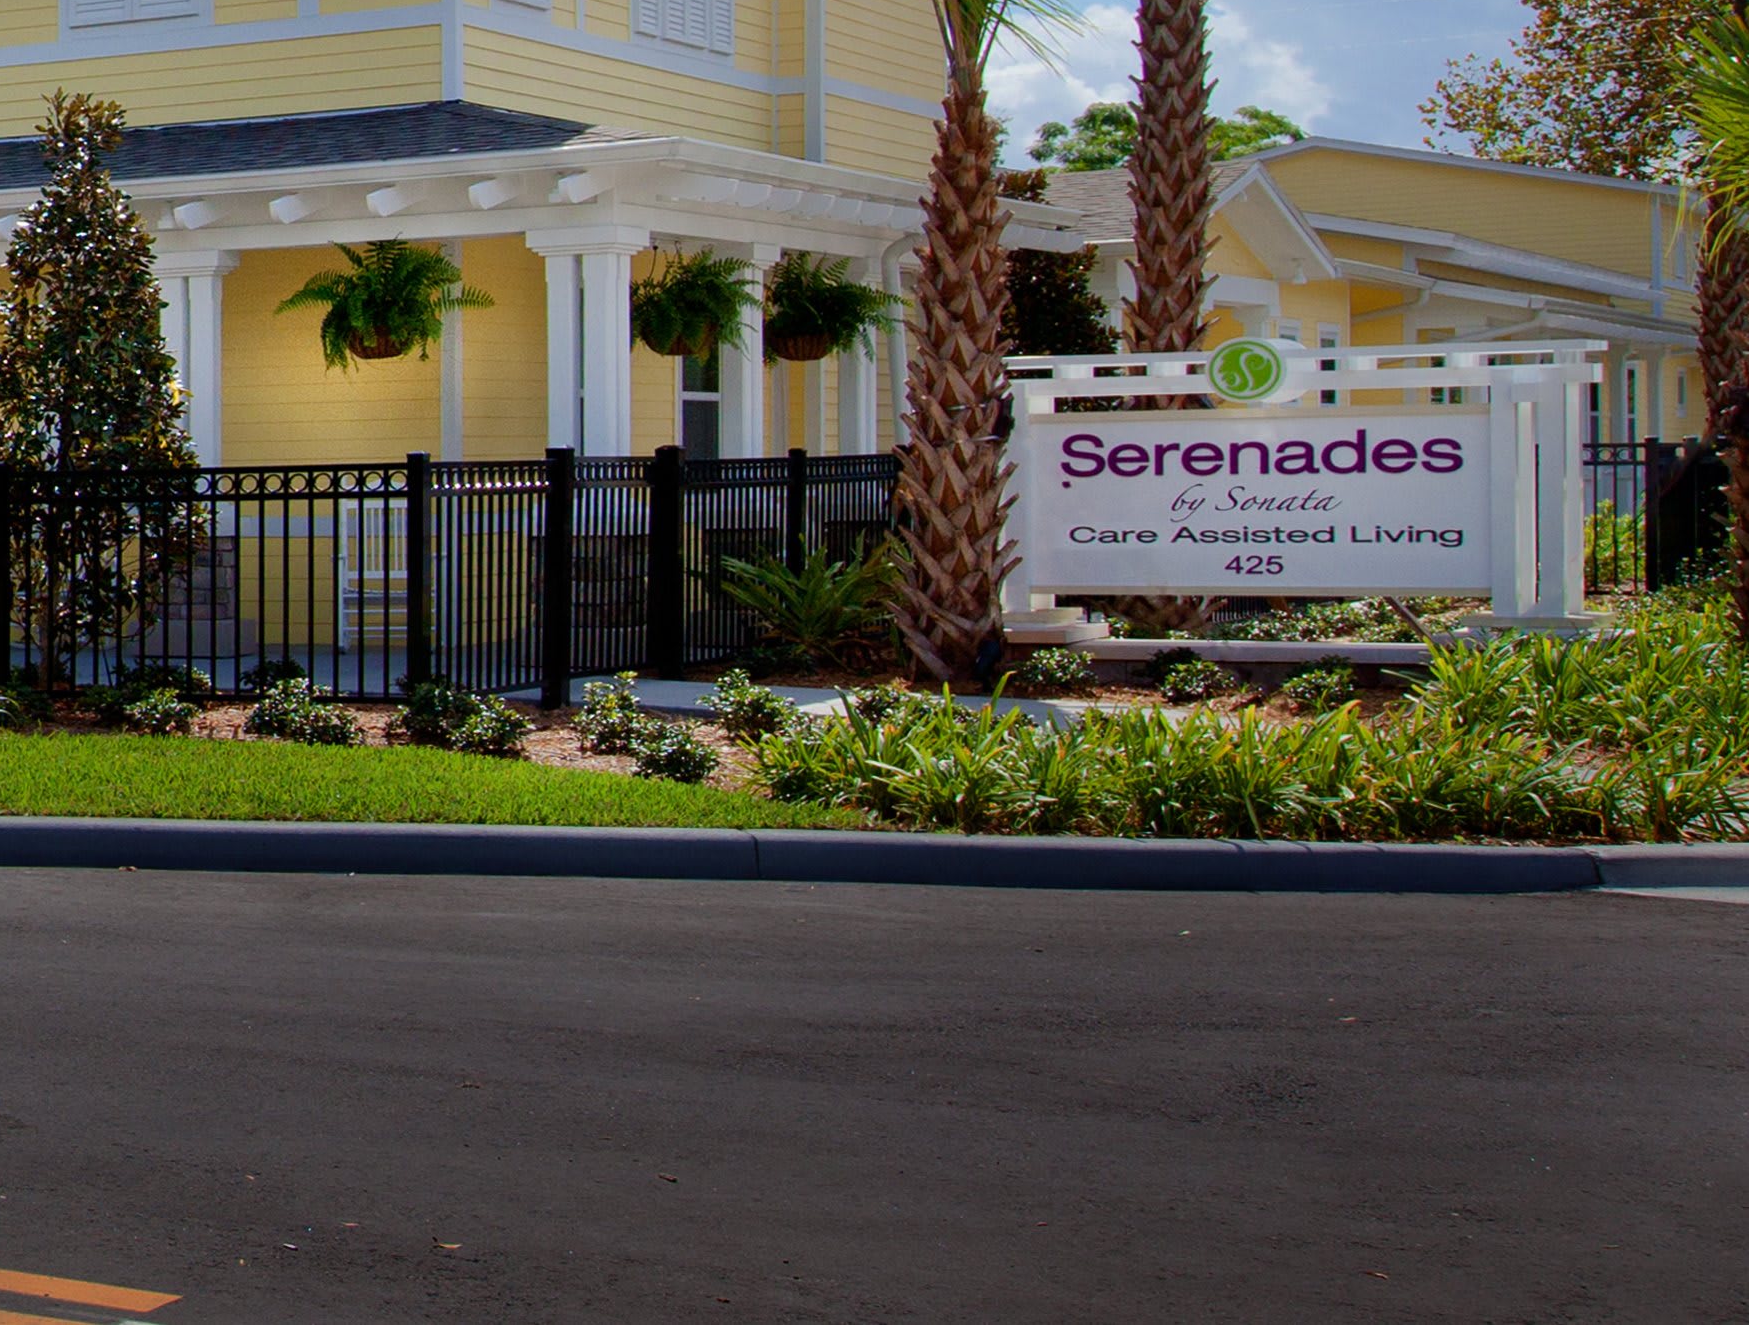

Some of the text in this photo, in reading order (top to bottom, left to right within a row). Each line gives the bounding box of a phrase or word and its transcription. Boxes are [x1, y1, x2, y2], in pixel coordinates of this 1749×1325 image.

[1059, 428, 1465, 480] Serenades
[1170, 483, 1342, 523] by Sonata
[1068, 525, 1466, 549] Care Assisted Living
[1224, 555, 1285, 575] 425
